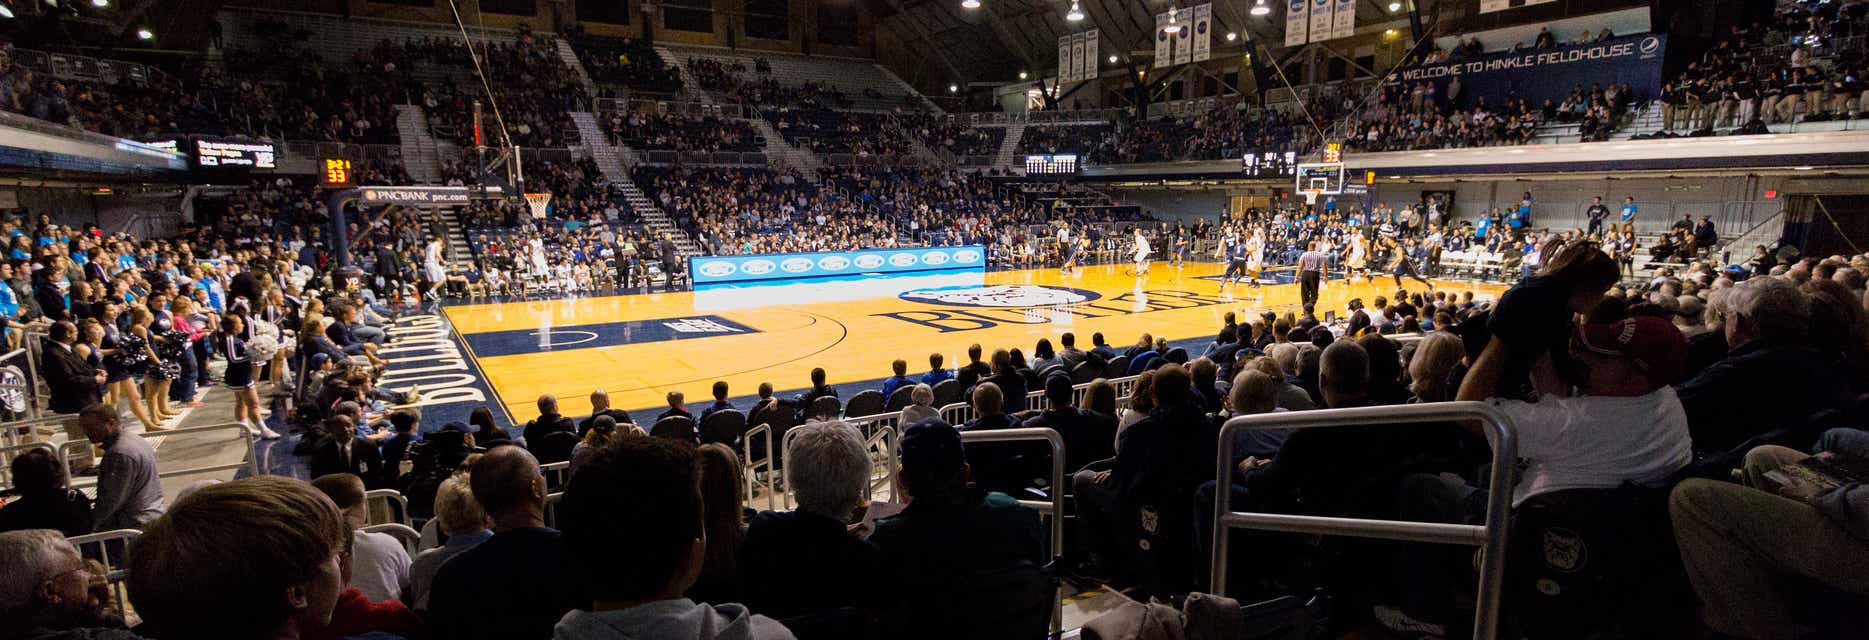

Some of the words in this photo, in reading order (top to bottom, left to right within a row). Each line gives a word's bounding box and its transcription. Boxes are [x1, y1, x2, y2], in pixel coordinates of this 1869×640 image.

[1402, 64, 1462, 80] WELCOME
[1465, 61, 1484, 74] TO
[1486, 55, 1534, 70] HINKLE
[1537, 43, 1635, 64] FIELDHOUSE
[328, 169, 346, 183] 33
[432, 194, 468, 202] pnc.com
[867, 289, 1243, 332] BUTLER
